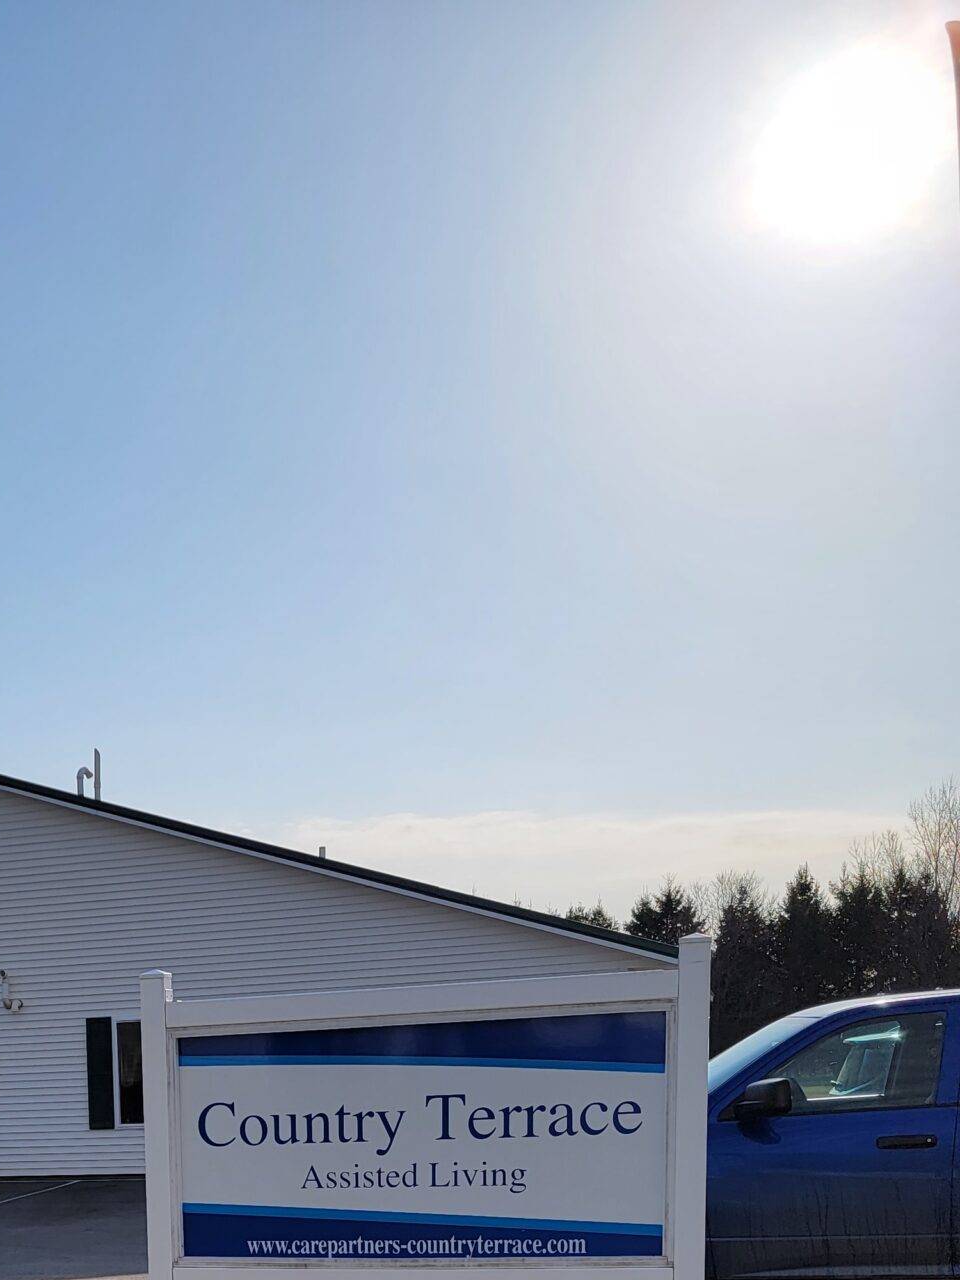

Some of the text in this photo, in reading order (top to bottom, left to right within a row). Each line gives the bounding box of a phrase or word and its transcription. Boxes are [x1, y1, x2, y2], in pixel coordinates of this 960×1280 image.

[198, 1094, 643, 1156] Country Terrace
[301, 1162, 527, 1193] Assisted Living
[247, 1235, 587, 1258] www.carepartners-countryterrace.com
